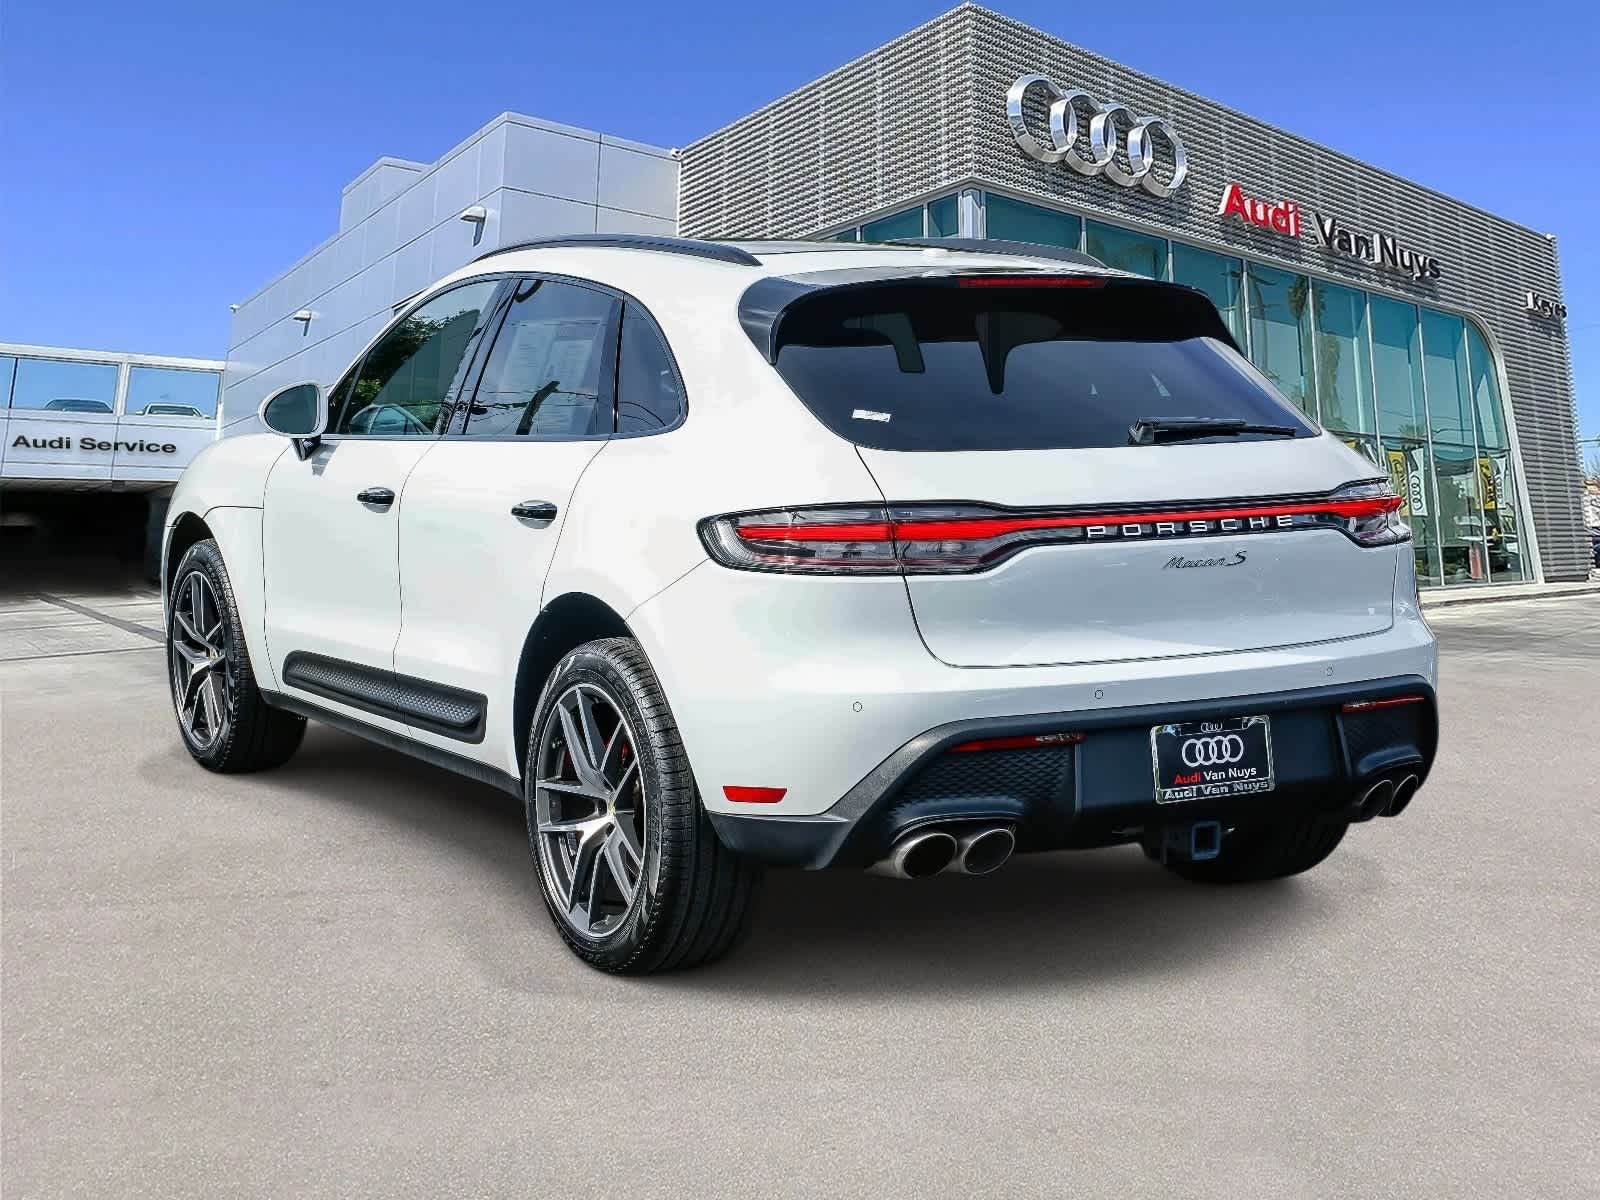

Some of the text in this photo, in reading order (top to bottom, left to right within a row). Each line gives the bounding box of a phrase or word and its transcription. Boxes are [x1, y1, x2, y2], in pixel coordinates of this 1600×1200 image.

[1219, 183, 1441, 280] Audi Van Nuys
[1527, 292, 1568, 319] Keyes
[12, 435, 177, 453] Audi Service
[1087, 515, 1293, 538] PORSCHE
[1162, 550, 1247, 569] Macan S
[1174, 766, 1257, 785] Audi Van Nuys
[1164, 780, 1268, 800] Audi Van Nuys
